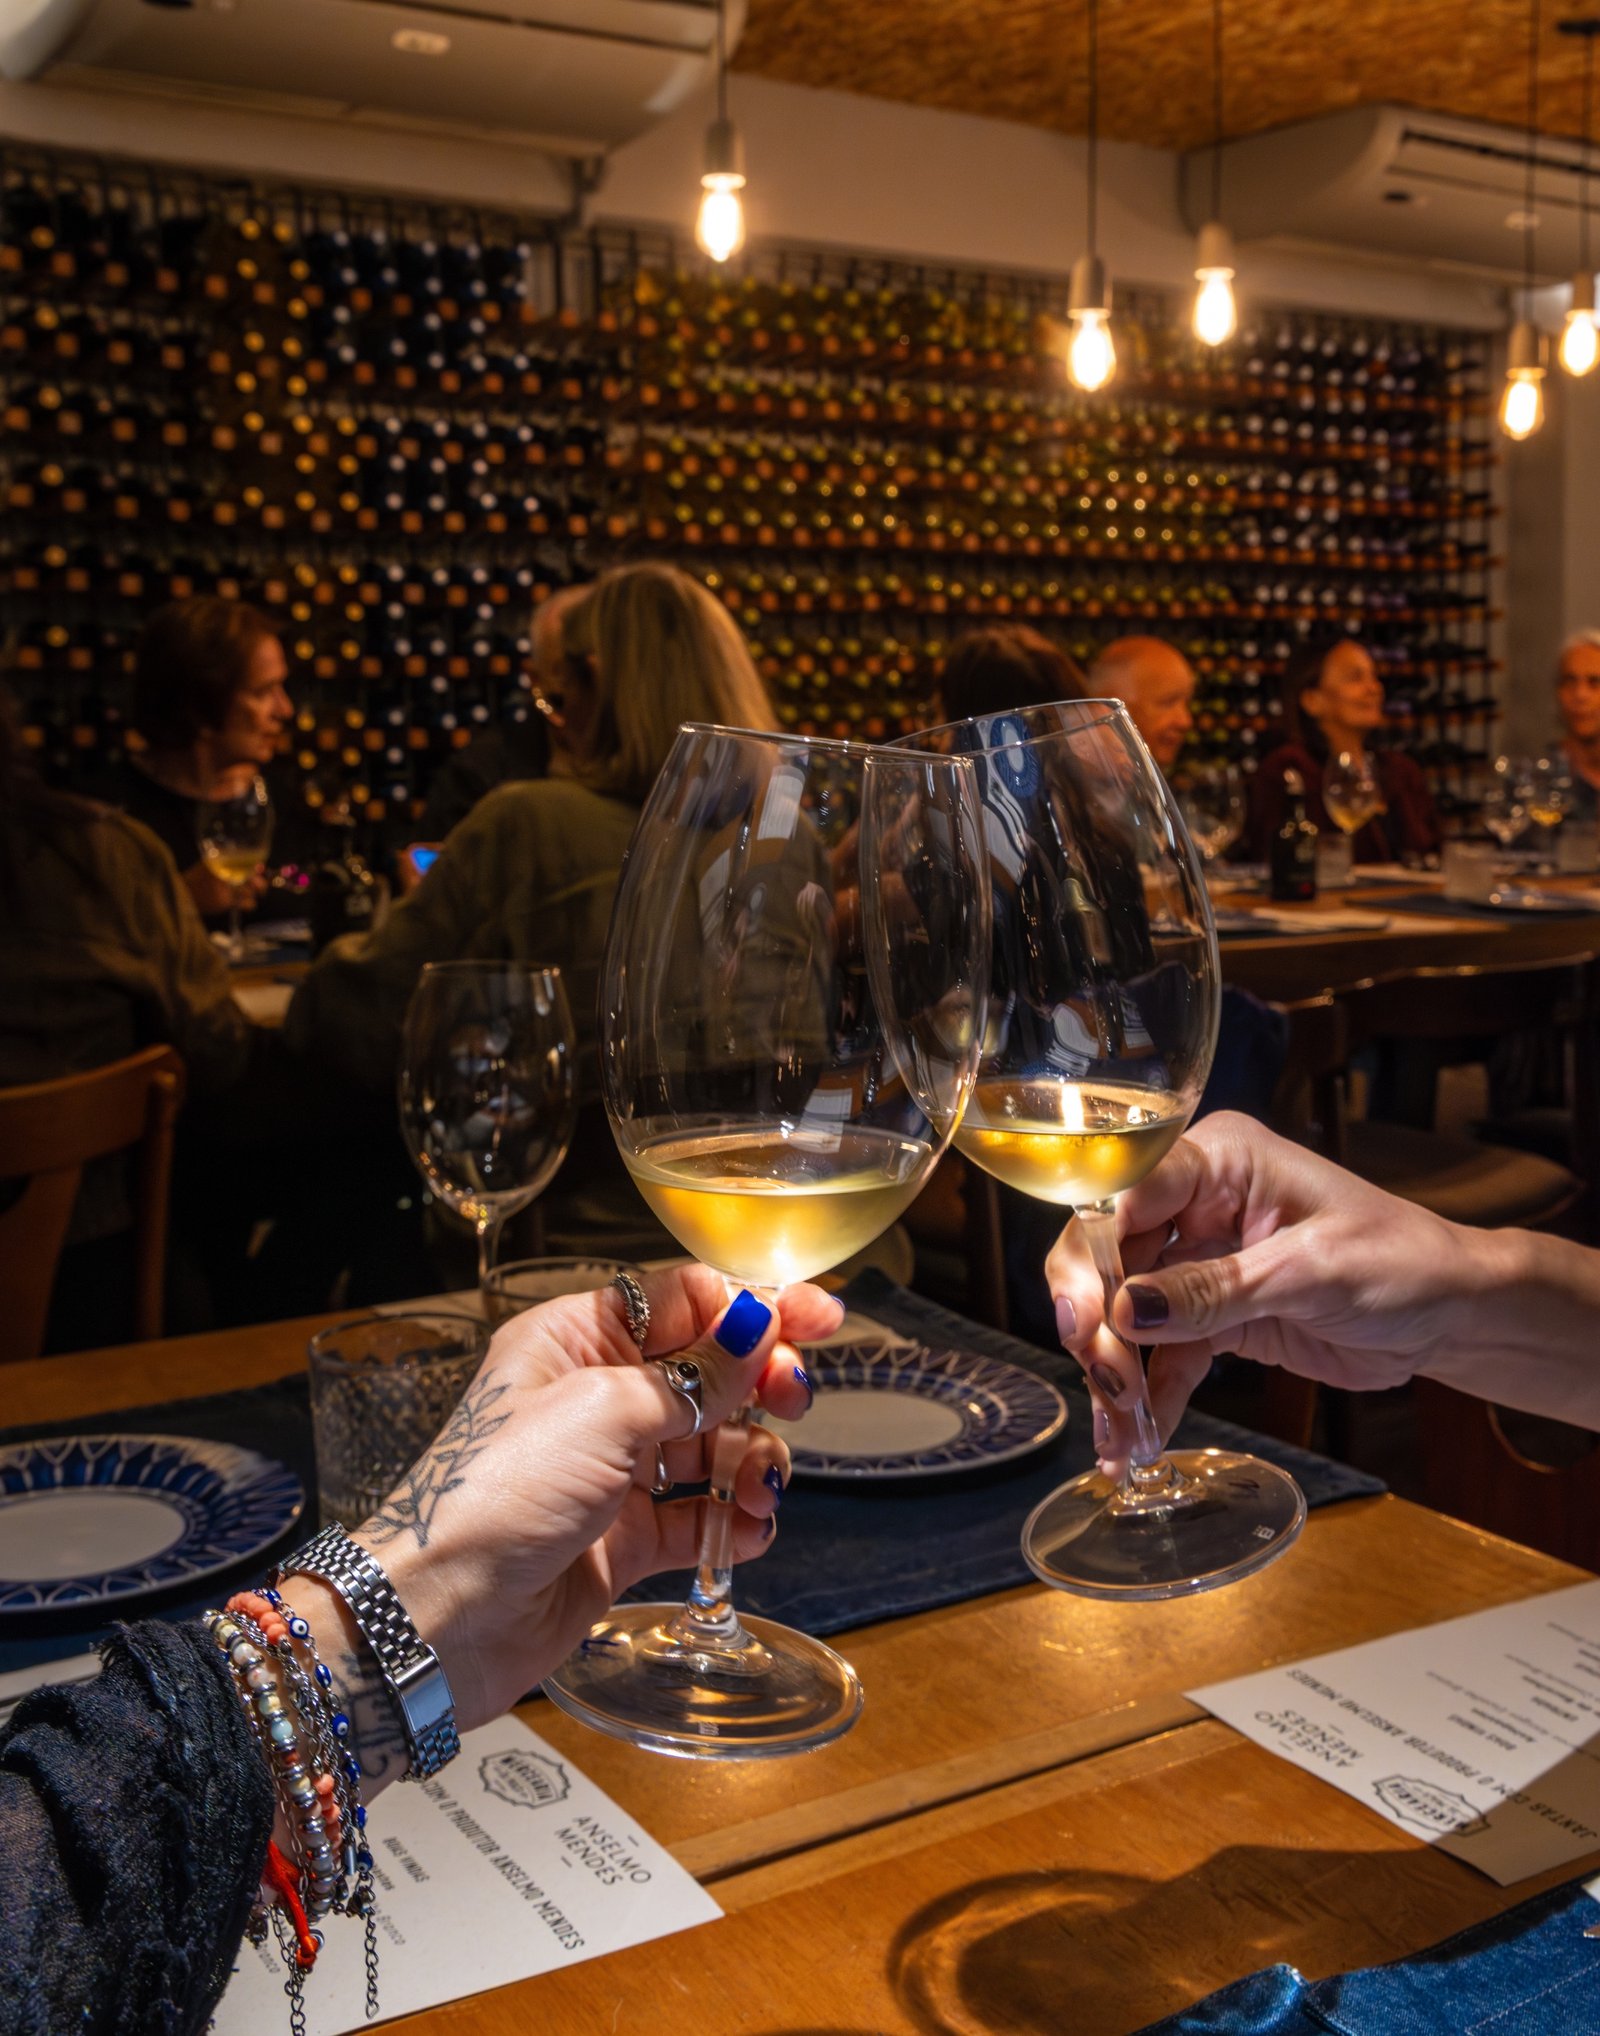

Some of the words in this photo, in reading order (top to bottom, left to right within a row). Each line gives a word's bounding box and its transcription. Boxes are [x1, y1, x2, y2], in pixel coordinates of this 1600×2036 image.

[1286, 1669, 1342, 1700] MENDES
[1254, 1710, 1352, 1767] ANSELMO
[1278, 1709, 1363, 1759] MENDES
[1338, 1700, 1405, 1736] ANSELMO
[501, 1755, 553, 1800] MERCEARIA
[1403, 1736, 1480, 1778] PRODUTOR
[424, 1780, 450, 1802] COM
[1477, 1776, 1494, 1785] O
[1492, 1783, 1530, 1804] COM
[438, 1800, 458, 1811] O
[1388, 1782, 1468, 1830] MERCEARIA
[1530, 1803, 1598, 1838] JANTAR
[446, 1808, 501, 1856] PRODUTOR
[573, 1816, 652, 1883] ANSELMO
[490, 1855, 545, 1901] ANSELMO
[554, 1827, 623, 1885] MENDES
[532, 1900, 585, 1950] MENDES
